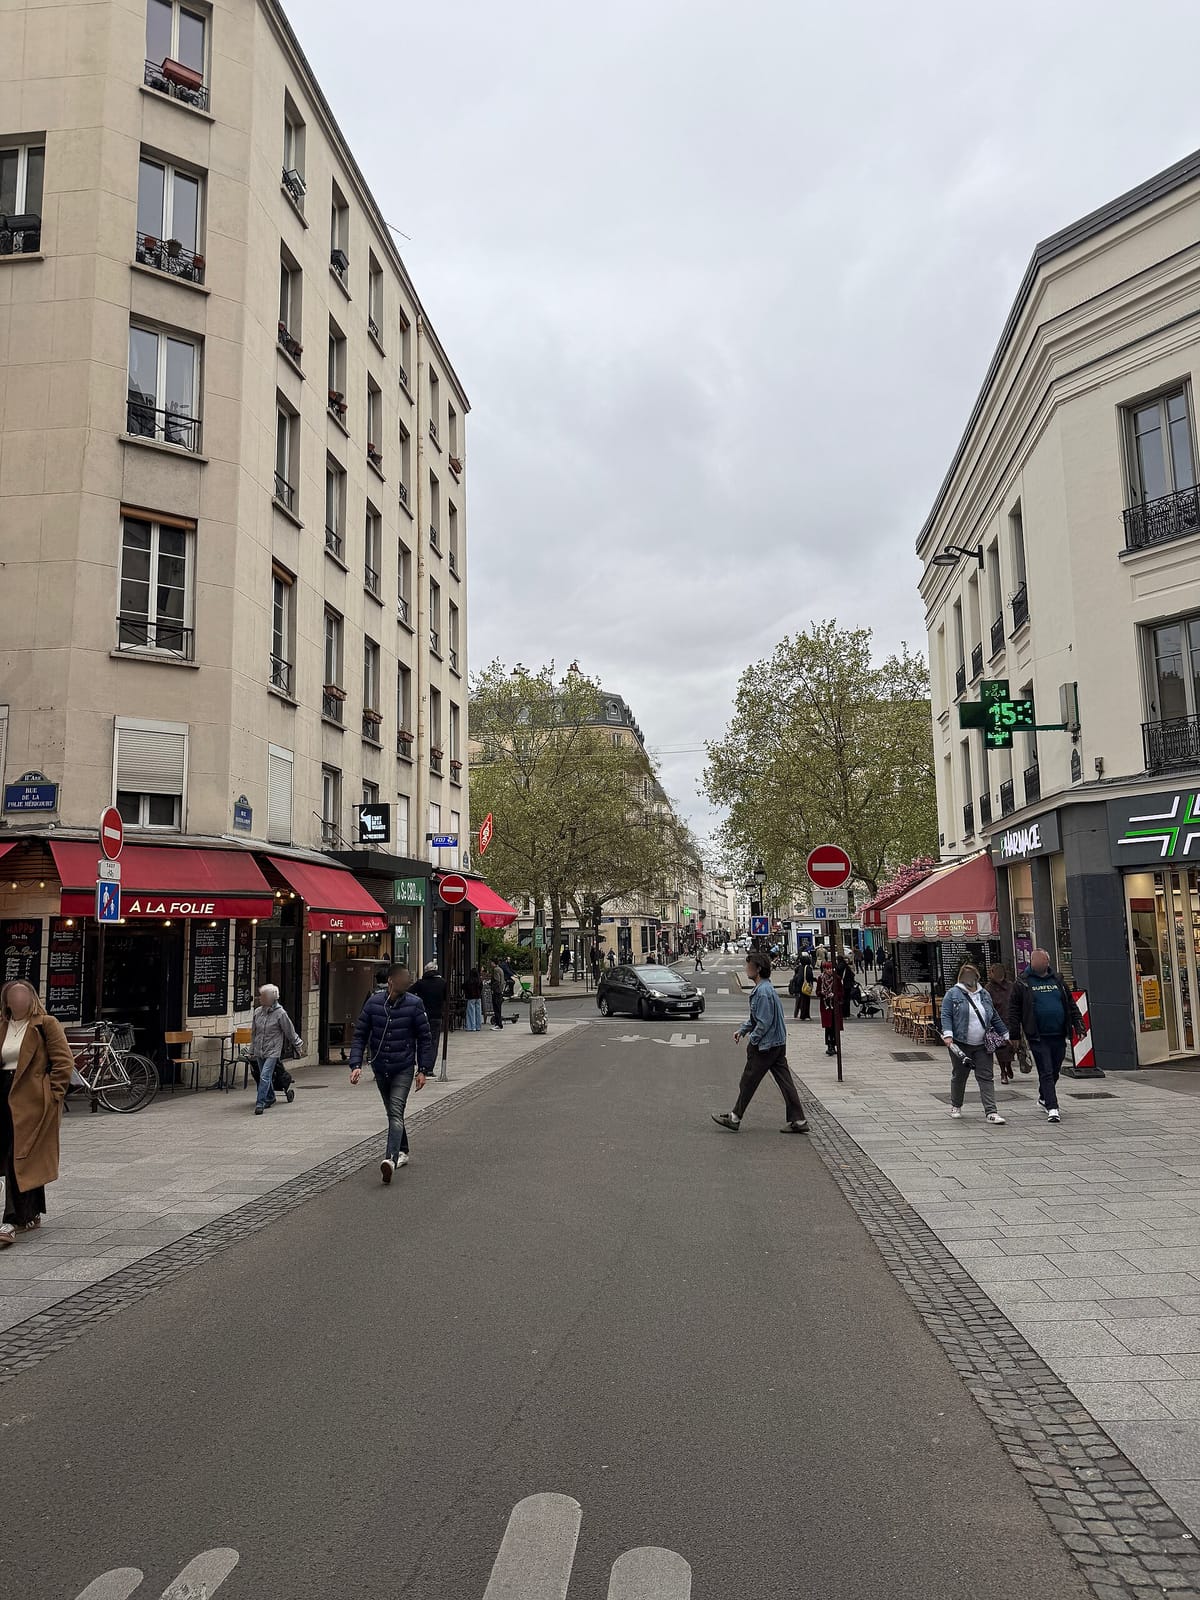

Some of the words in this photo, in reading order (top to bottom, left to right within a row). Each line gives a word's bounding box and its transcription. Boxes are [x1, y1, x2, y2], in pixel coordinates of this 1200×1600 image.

[999, 823, 1042, 859] PHARMACIE
[145, 901, 166, 913] LA
[169, 902, 216, 914] FOLIE
